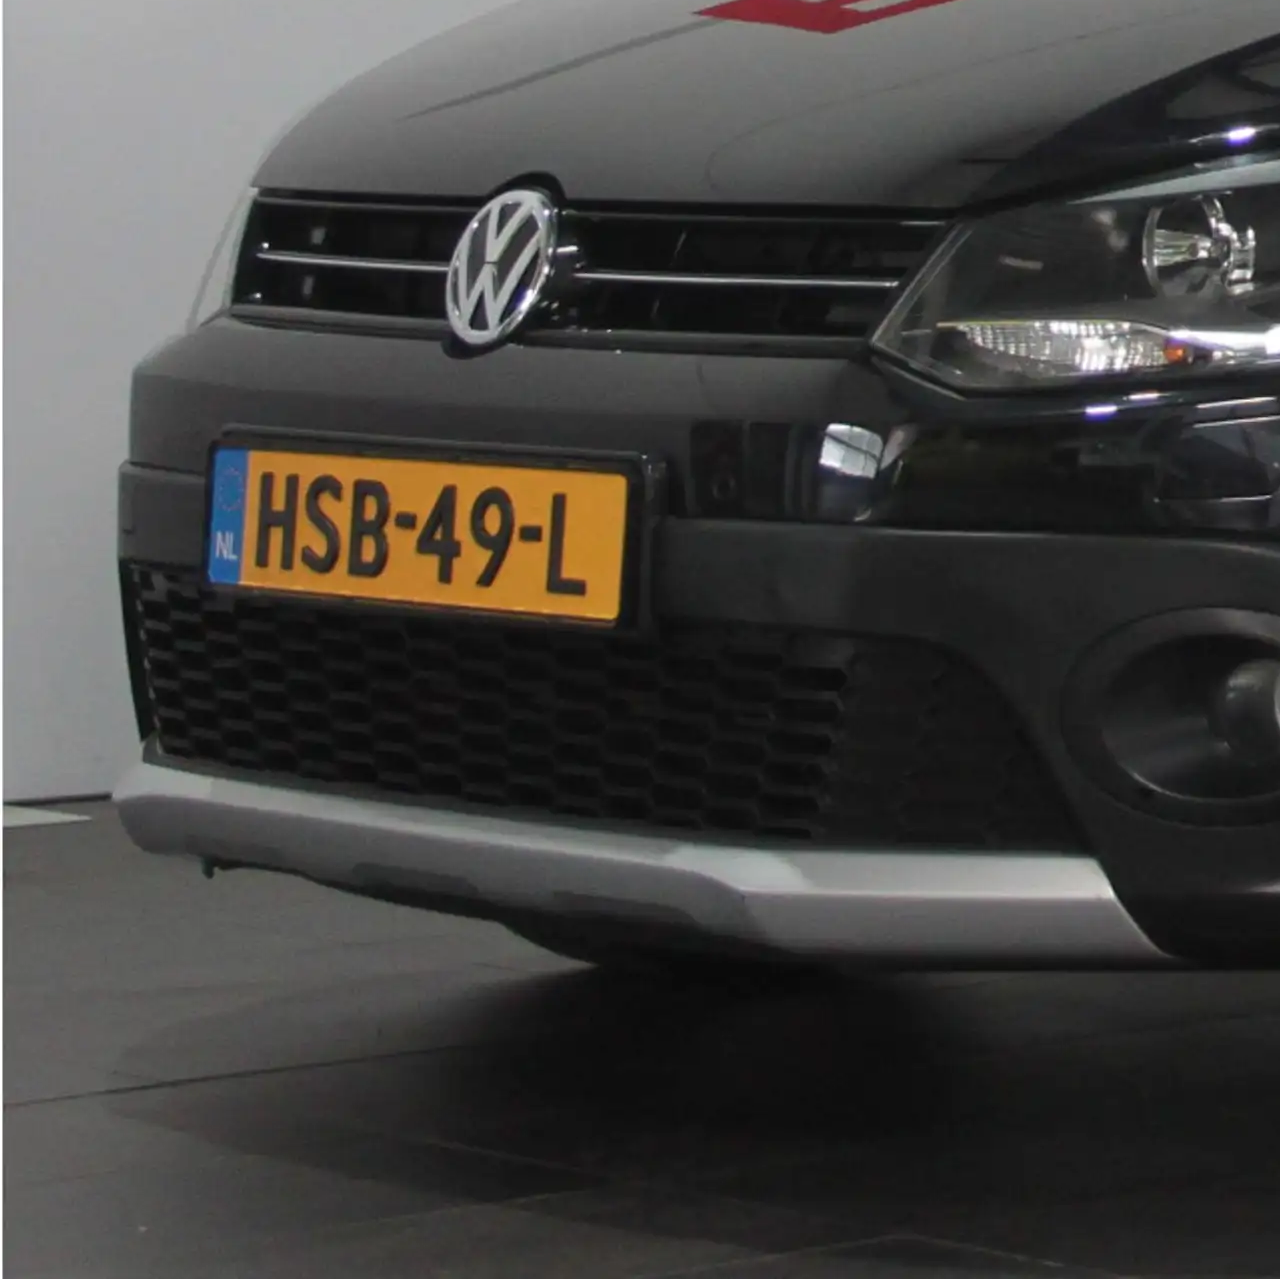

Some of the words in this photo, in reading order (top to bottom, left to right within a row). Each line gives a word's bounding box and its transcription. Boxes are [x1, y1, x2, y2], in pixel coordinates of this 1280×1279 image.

[446, 189, 552, 344] VW
[215, 531, 239, 560] NL
[254, 471, 588, 597] HSB-49-L
